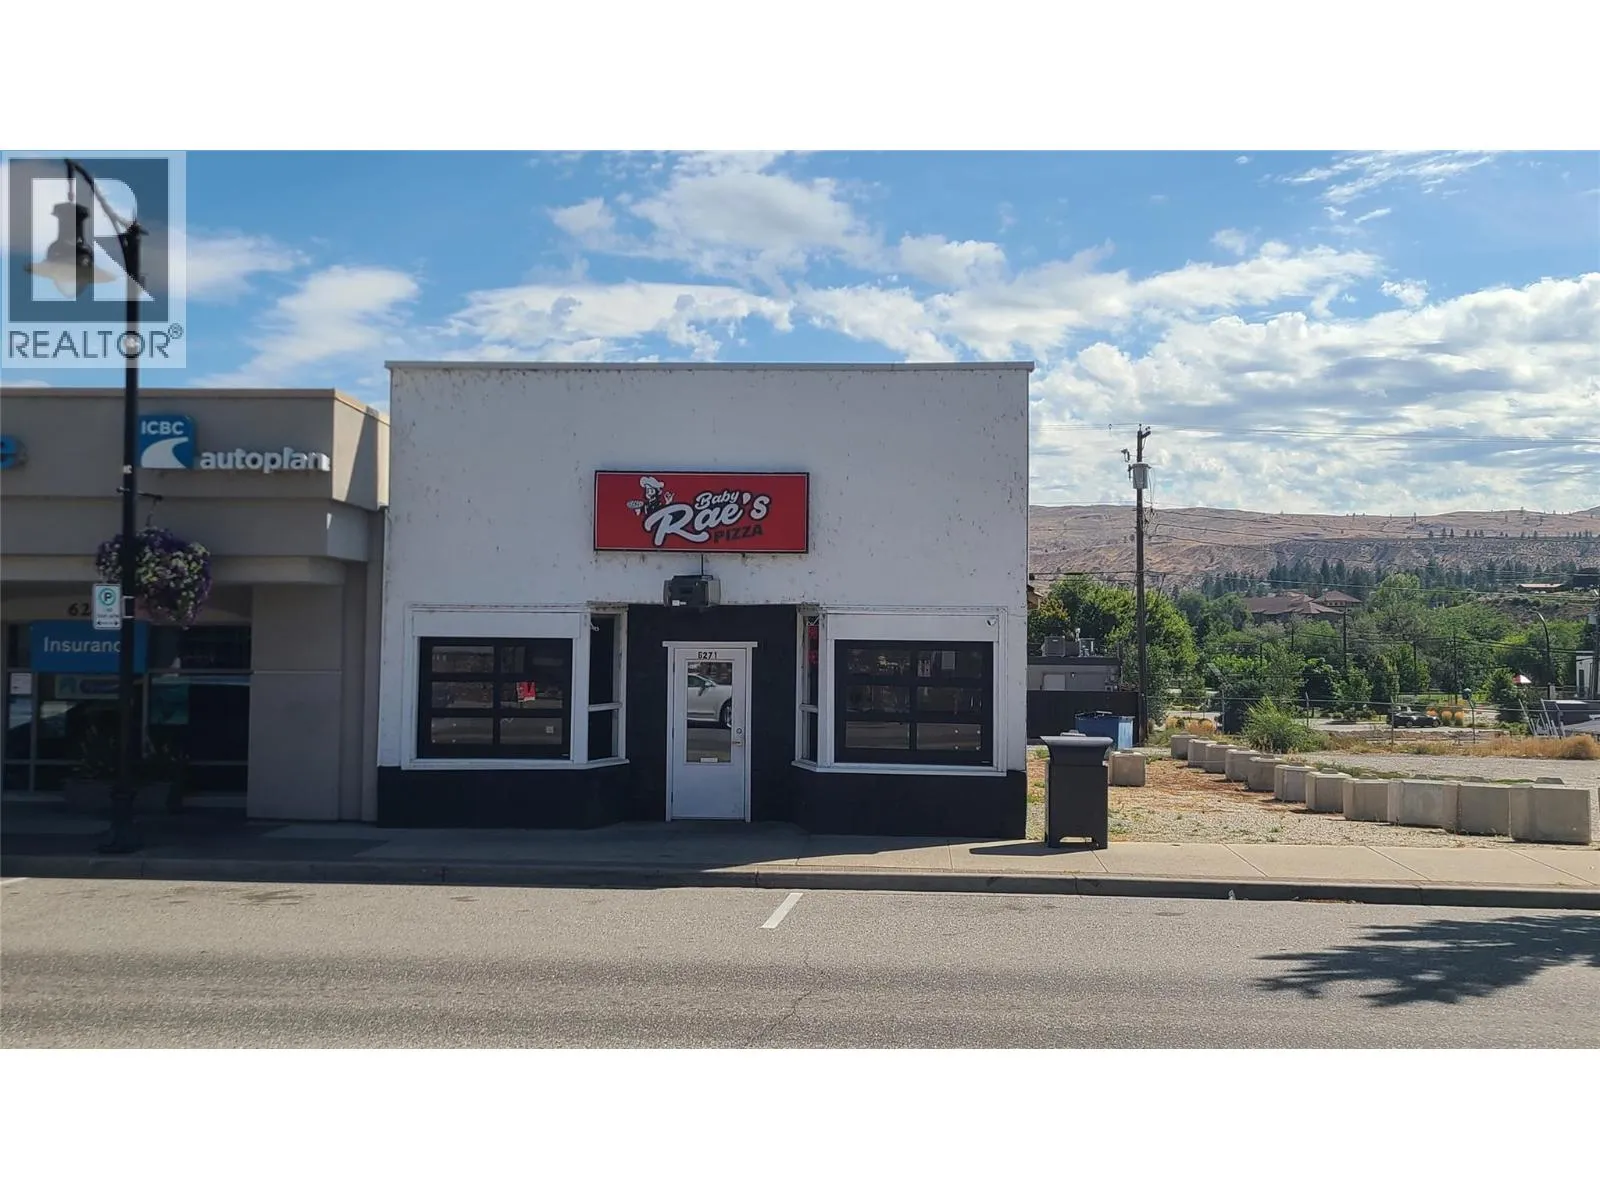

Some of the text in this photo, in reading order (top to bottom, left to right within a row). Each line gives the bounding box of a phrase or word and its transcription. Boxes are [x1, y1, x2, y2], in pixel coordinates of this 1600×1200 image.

[141, 420, 185, 436] ICBC
[199, 446, 331, 475] autoplan
[694, 490, 739, 511] Baby
[644, 492, 771, 547] Rae's
[712, 523, 764, 544] PIZZA
[104, 592, 113, 602] P
[68, 603, 92, 617] 62
[43, 636, 121, 653] Insuranc
